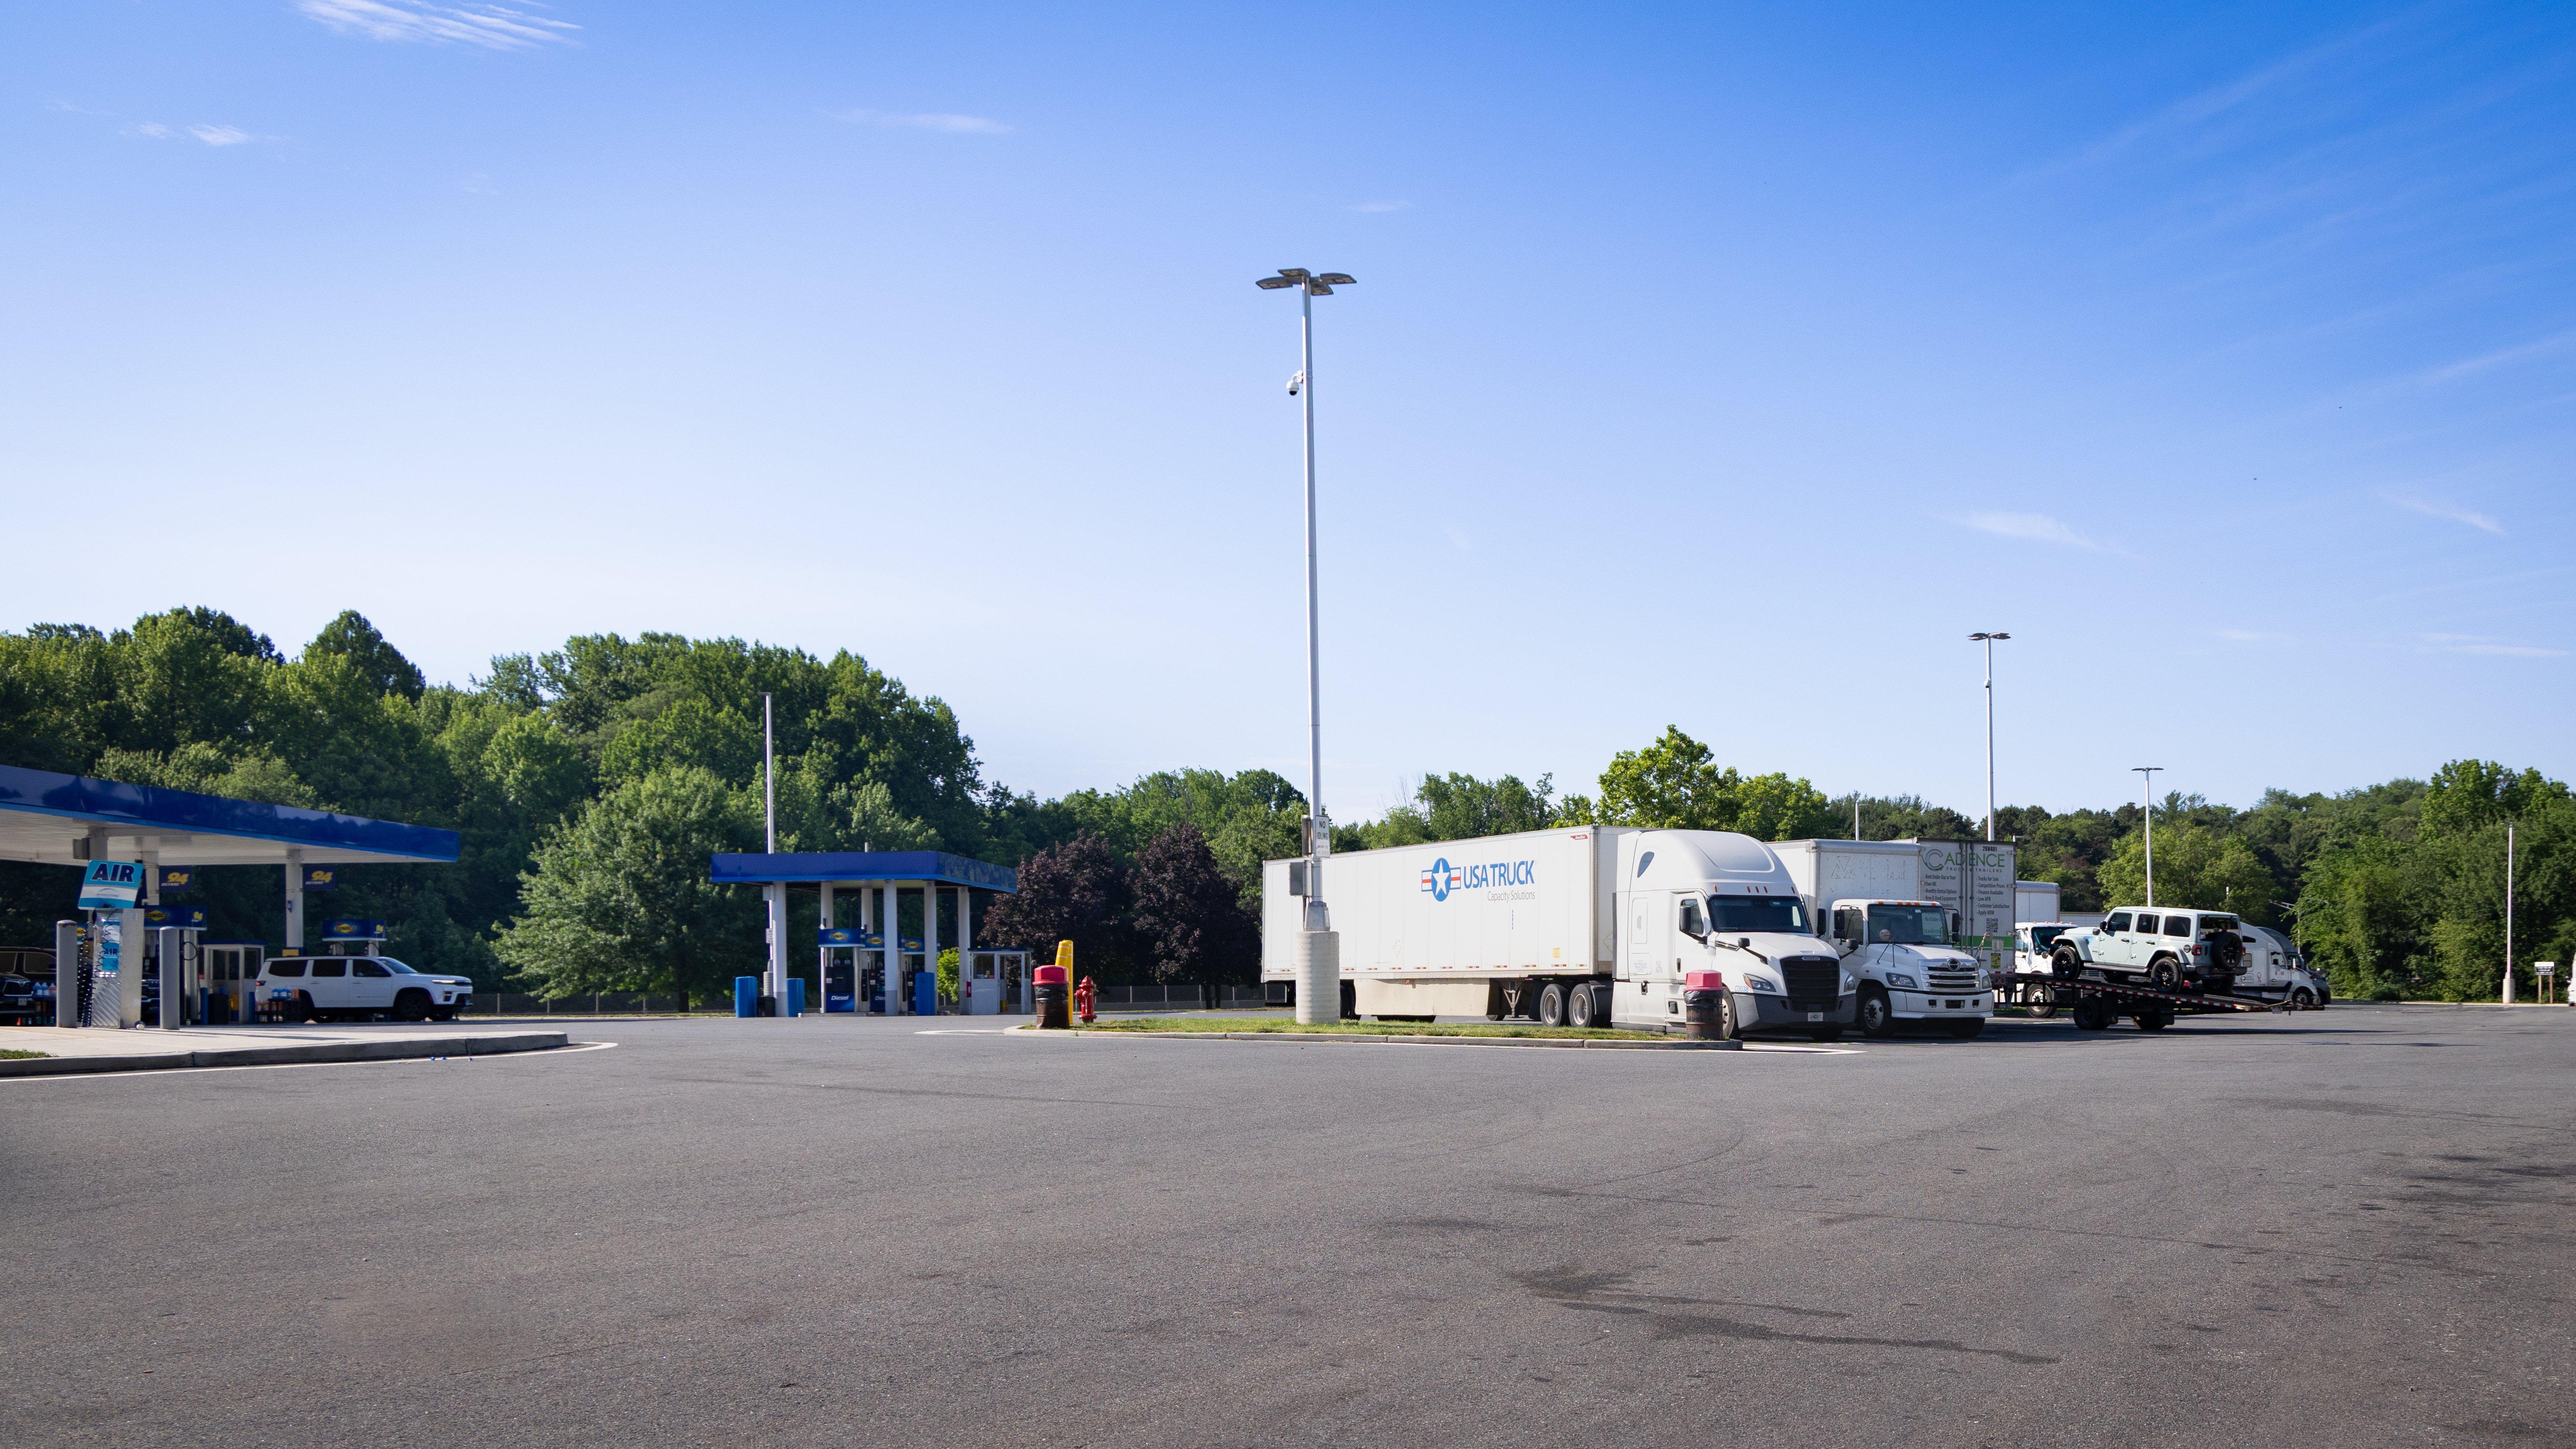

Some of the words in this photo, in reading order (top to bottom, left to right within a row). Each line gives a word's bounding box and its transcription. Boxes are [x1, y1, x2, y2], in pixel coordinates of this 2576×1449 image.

[1317, 832, 1328, 840] IDLING
[1922, 849, 2004, 871] CADENCE
[90, 863, 134, 883] AIR
[167, 872, 189, 885] 94
[311, 871, 333, 883] 94
[1464, 865, 1489, 889] USA
[1490, 860, 1535, 887] TRUCK
[1488, 891, 1510, 903] Capacity
[1511, 890, 1535, 901] Solutions
